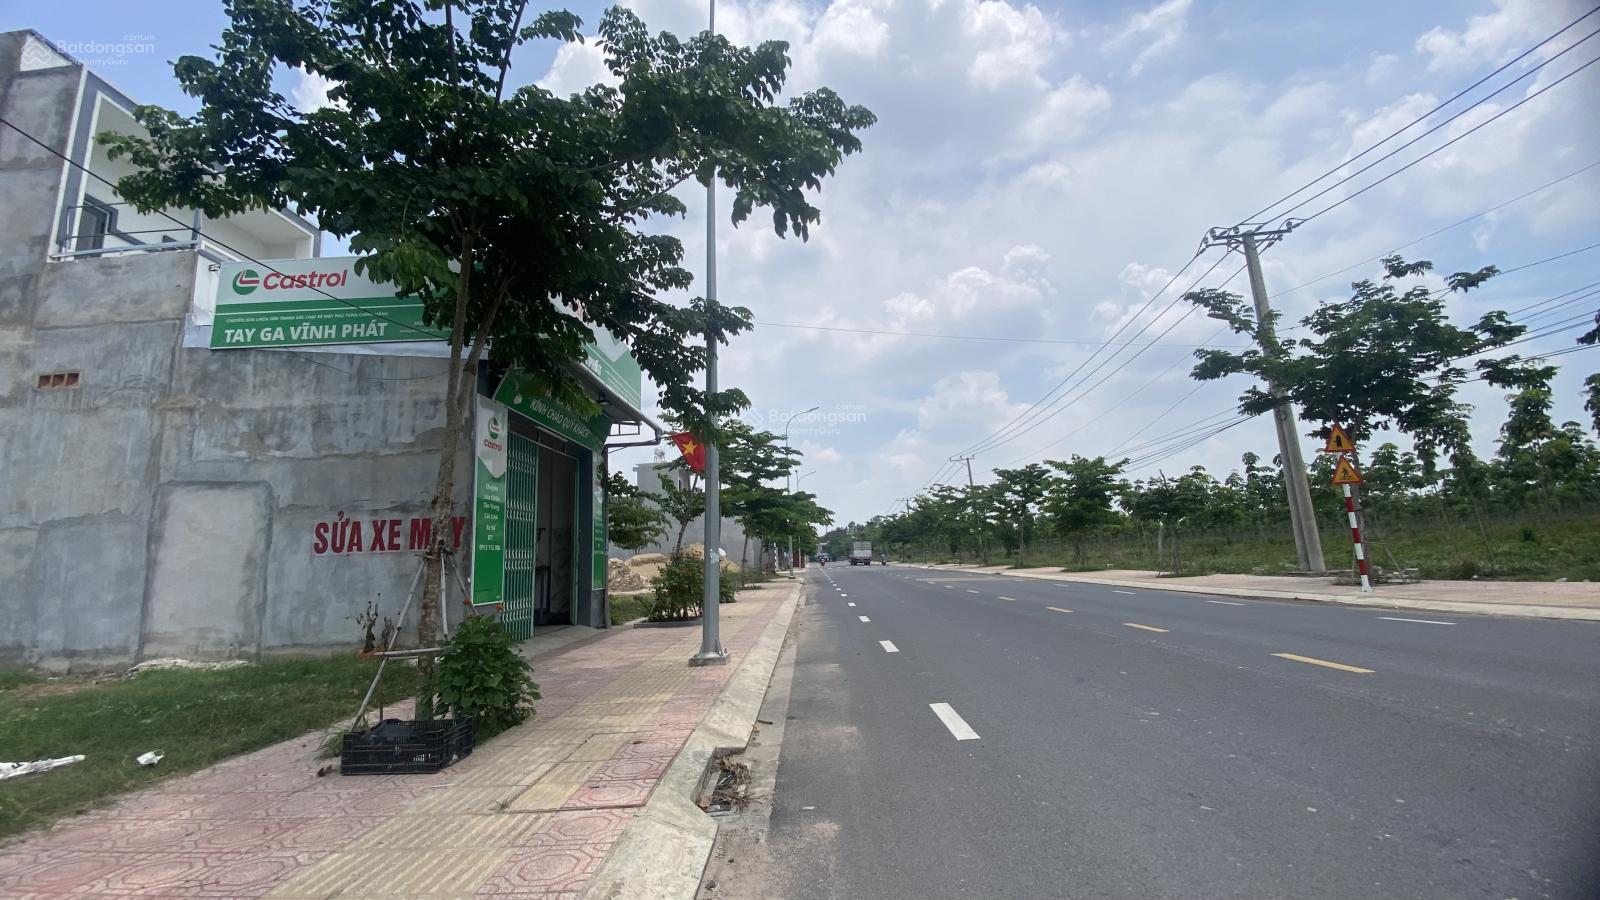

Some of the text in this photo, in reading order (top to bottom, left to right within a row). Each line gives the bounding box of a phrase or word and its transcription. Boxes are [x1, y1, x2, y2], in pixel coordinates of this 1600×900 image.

[263, 269, 348, 290] Castrol
[224, 319, 388, 343] TAY GA VĨNH PHÁT
[484, 439, 502, 452] Castrol
[313, 510, 465, 555] SỬA XE MY
